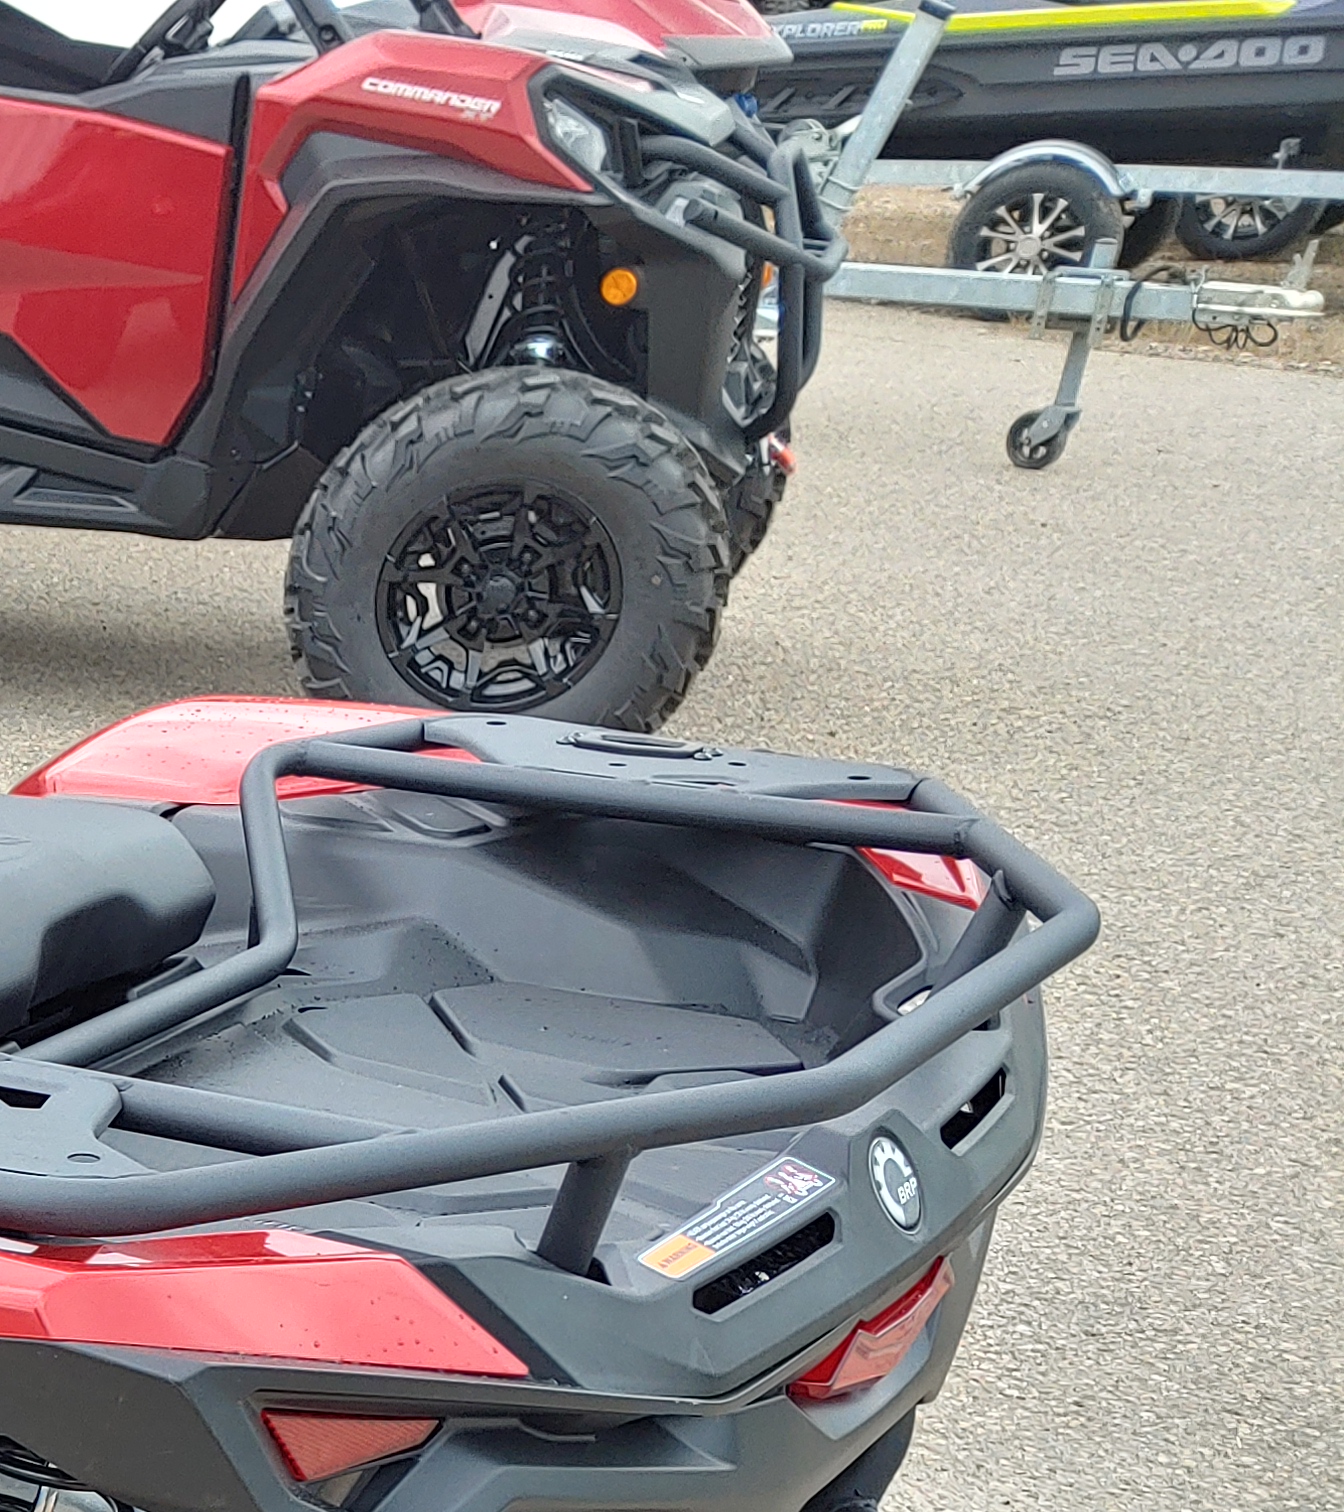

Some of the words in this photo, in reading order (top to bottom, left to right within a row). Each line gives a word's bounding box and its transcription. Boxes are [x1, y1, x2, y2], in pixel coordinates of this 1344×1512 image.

[771, 20, 860, 39] XPLORER
[361, 76, 502, 115] COMMANDER
[897, 1176, 918, 1205] BRP
